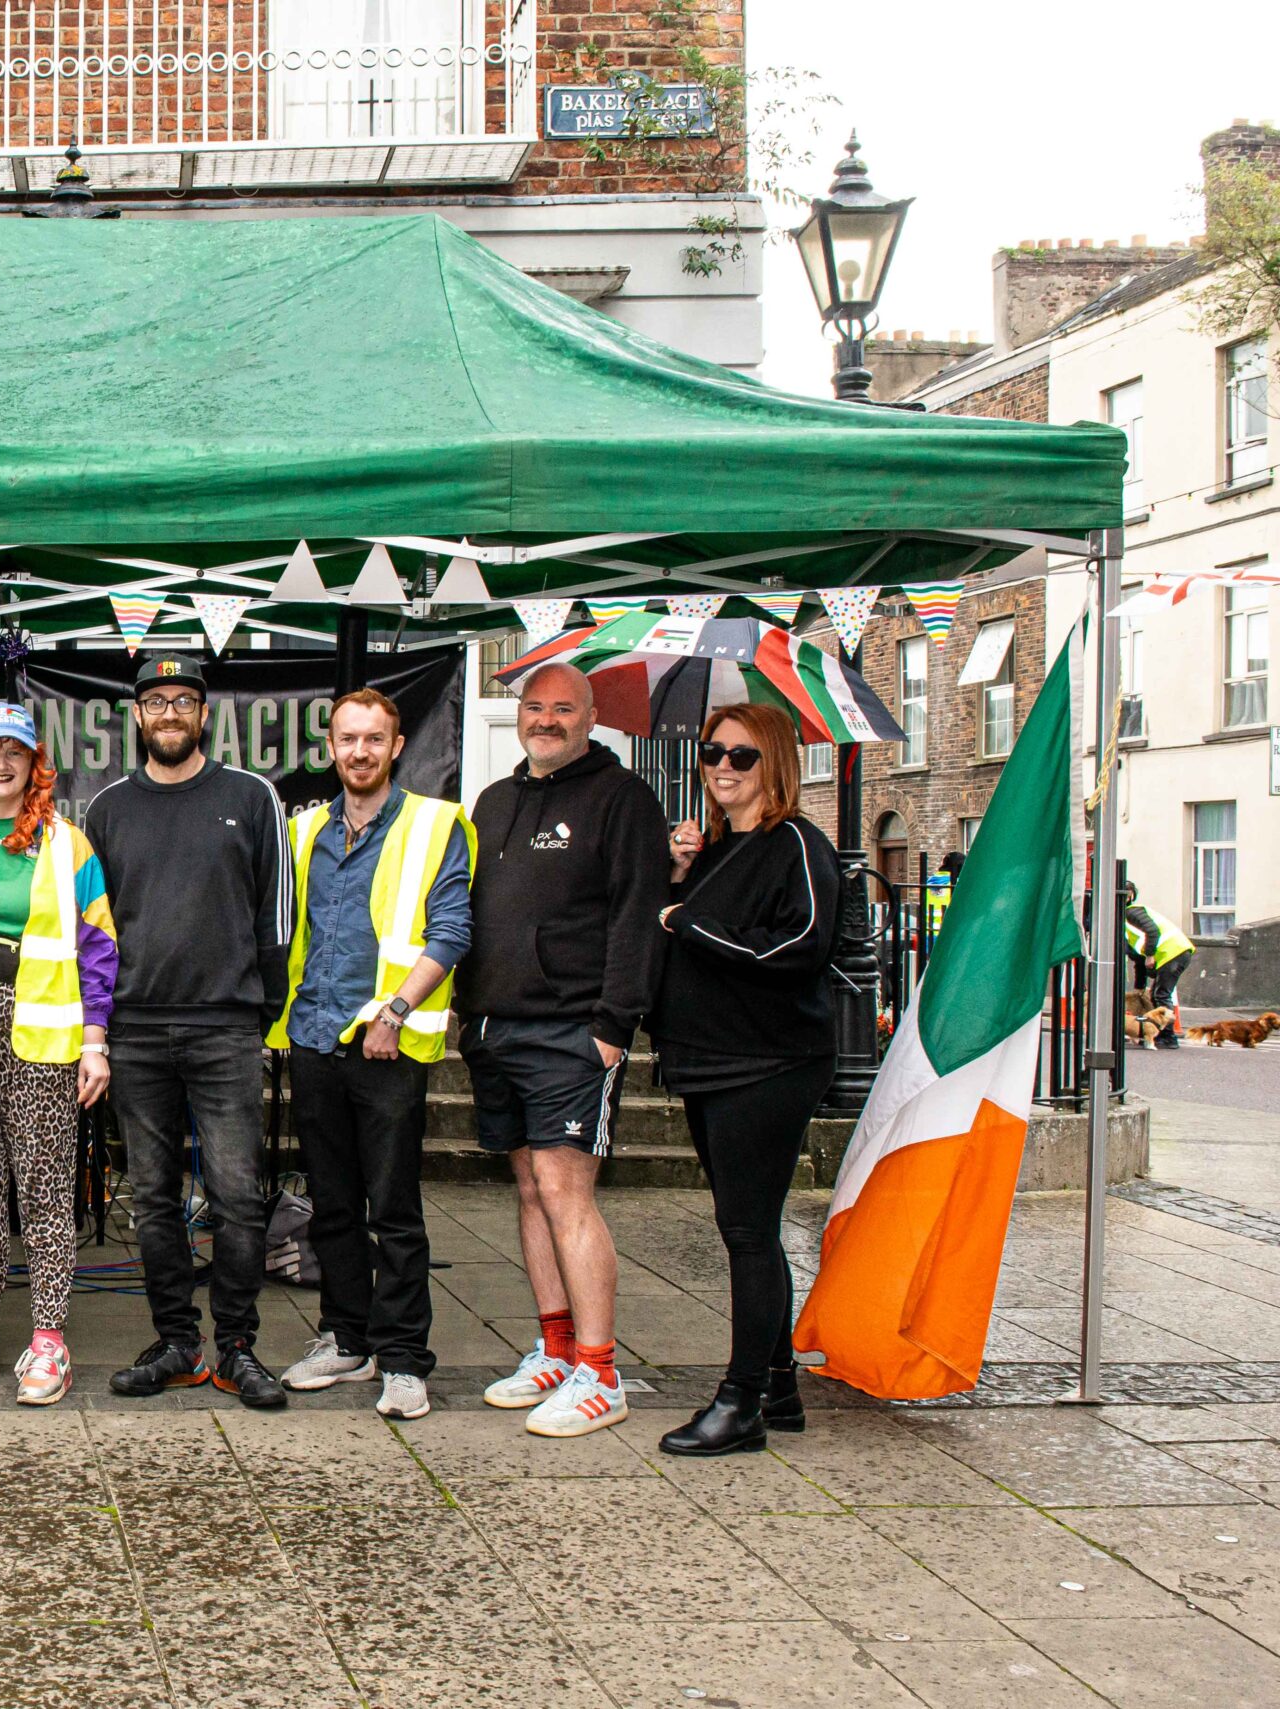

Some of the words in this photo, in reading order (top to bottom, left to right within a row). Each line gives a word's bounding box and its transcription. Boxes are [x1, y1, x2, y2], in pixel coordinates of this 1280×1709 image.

[560, 93, 629, 111] BAKER
[536, 831, 552, 841] PX
[533, 840, 569, 850] MUSIC
